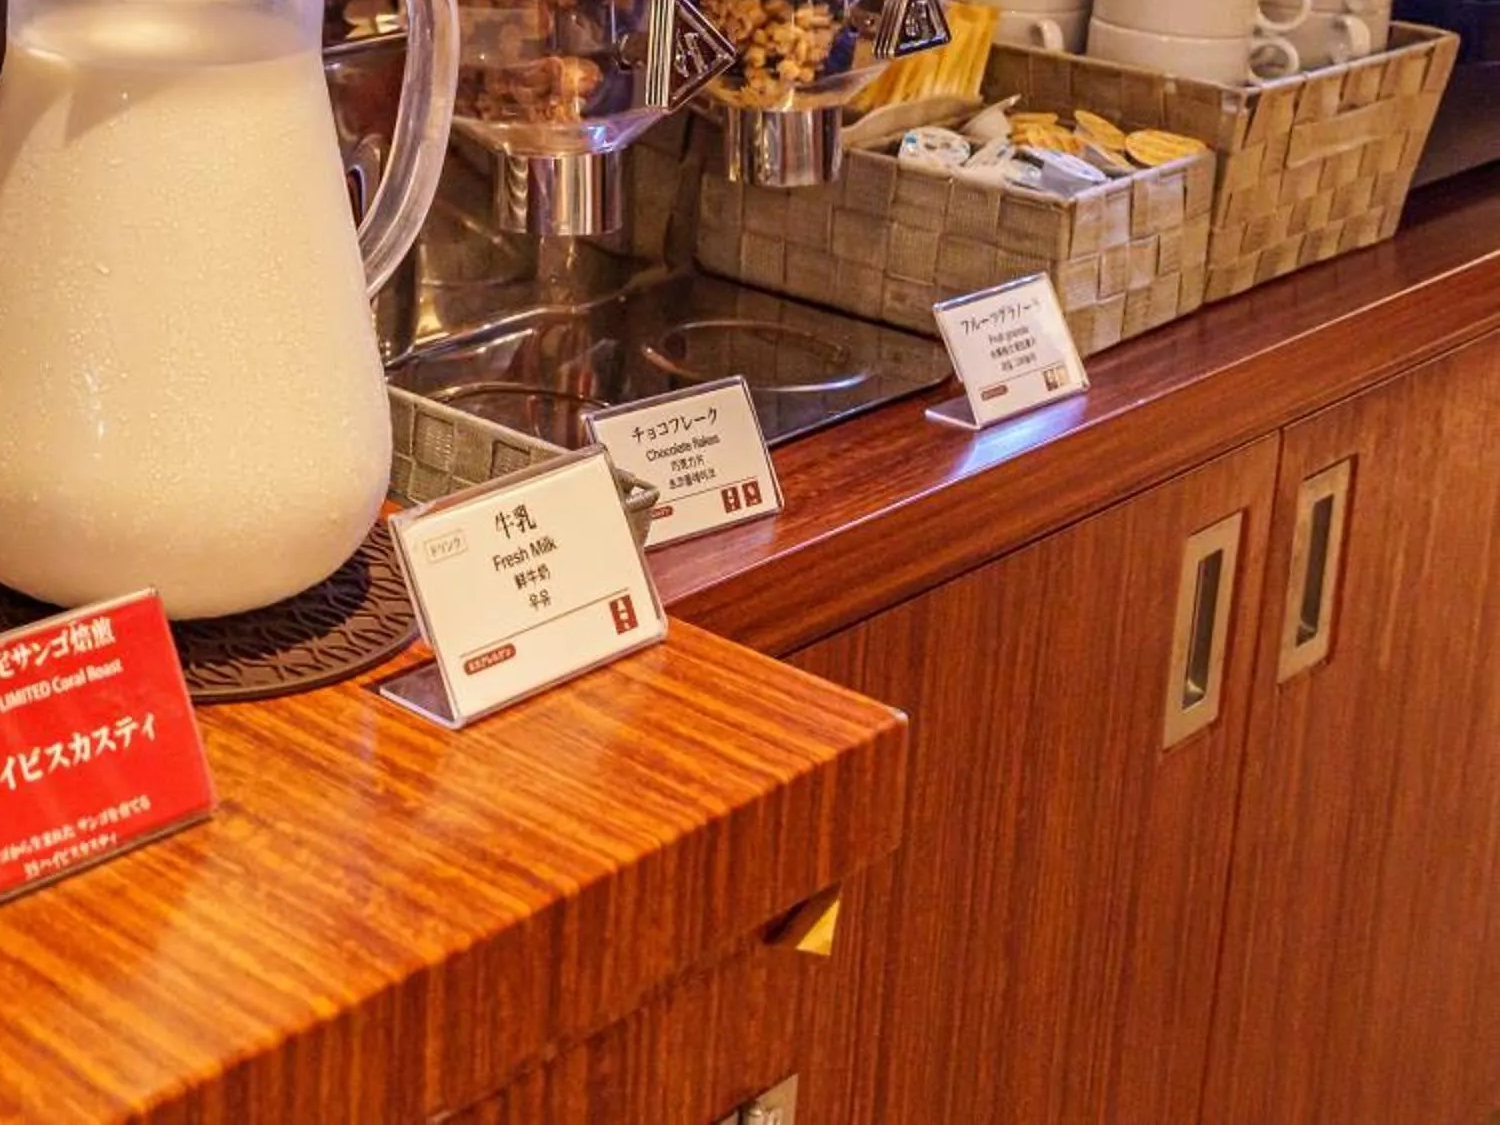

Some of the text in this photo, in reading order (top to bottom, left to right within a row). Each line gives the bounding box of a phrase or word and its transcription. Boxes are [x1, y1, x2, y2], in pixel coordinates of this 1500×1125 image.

[631, 406, 718, 443] チョコフレーク
[646, 442, 692, 462] Chocolate
[494, 504, 537, 540] 牛乳
[492, 536, 558, 572] Fresh Milk
[51, 668, 86, 694] Coral
